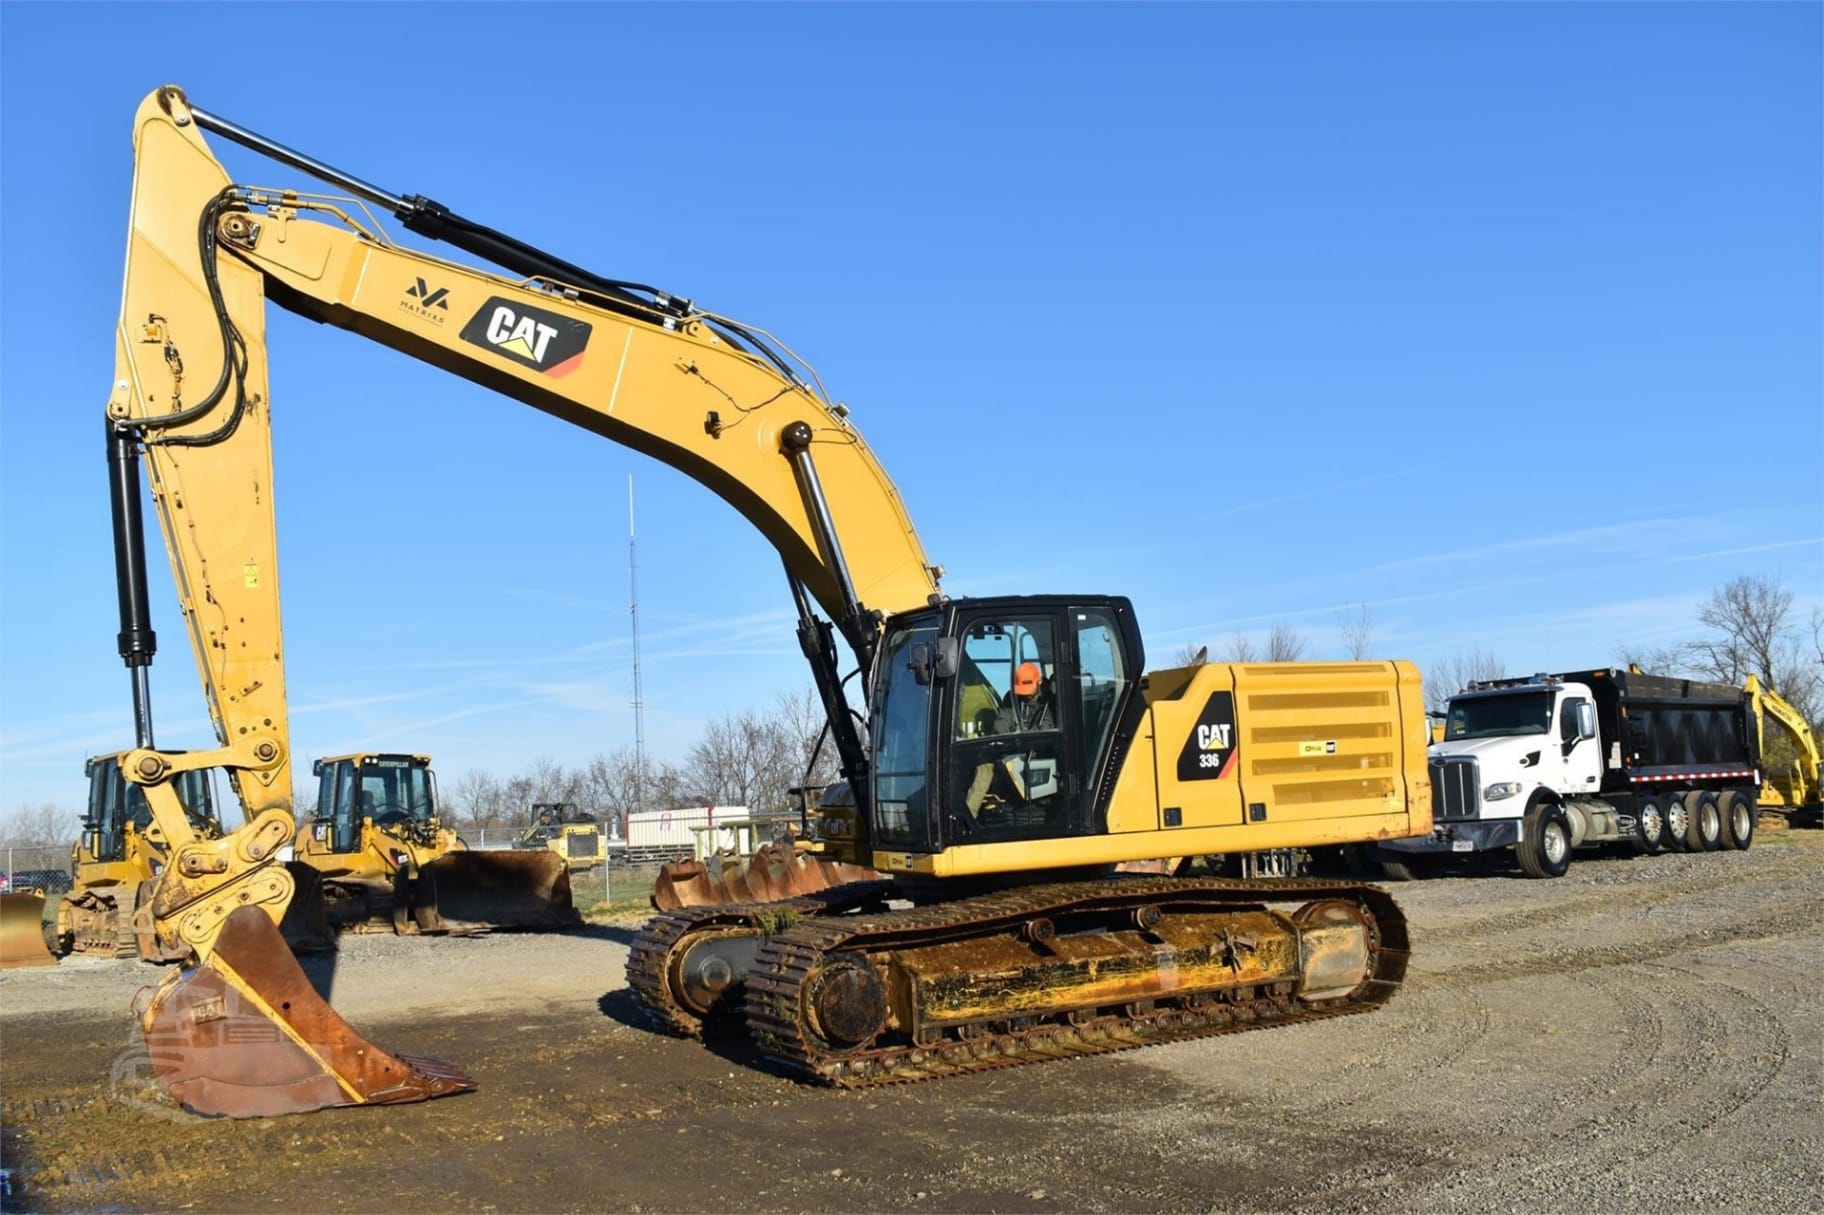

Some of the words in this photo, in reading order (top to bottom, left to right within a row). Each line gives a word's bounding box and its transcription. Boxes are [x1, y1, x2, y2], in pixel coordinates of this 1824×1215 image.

[400, 301, 444, 323] MATRIXS
[486, 306, 558, 364] CAT
[1197, 724, 1231, 750] CAT
[1199, 753, 1220, 768] 336
